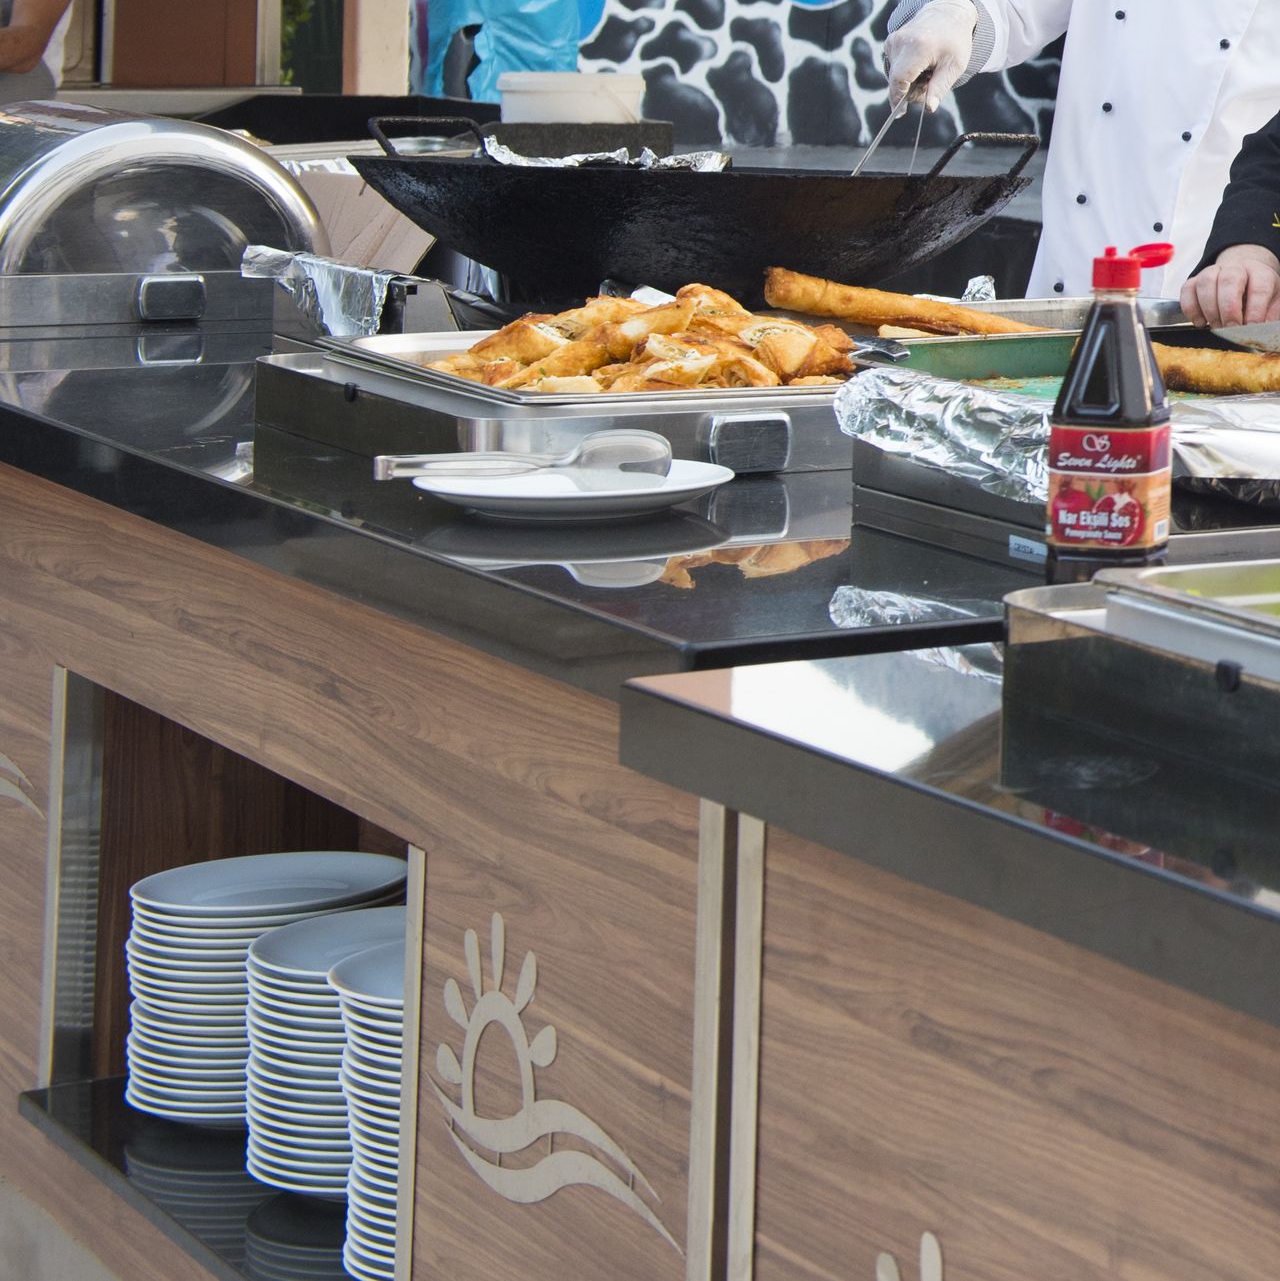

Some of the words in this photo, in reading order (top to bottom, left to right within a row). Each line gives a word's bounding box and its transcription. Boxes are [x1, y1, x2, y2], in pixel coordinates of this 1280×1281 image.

[1056, 452, 1093, 467] Seven
[1094, 453, 1137, 472] Lights
[1058, 509, 1078, 525] Nar
[1110, 512, 1131, 528] Sos
